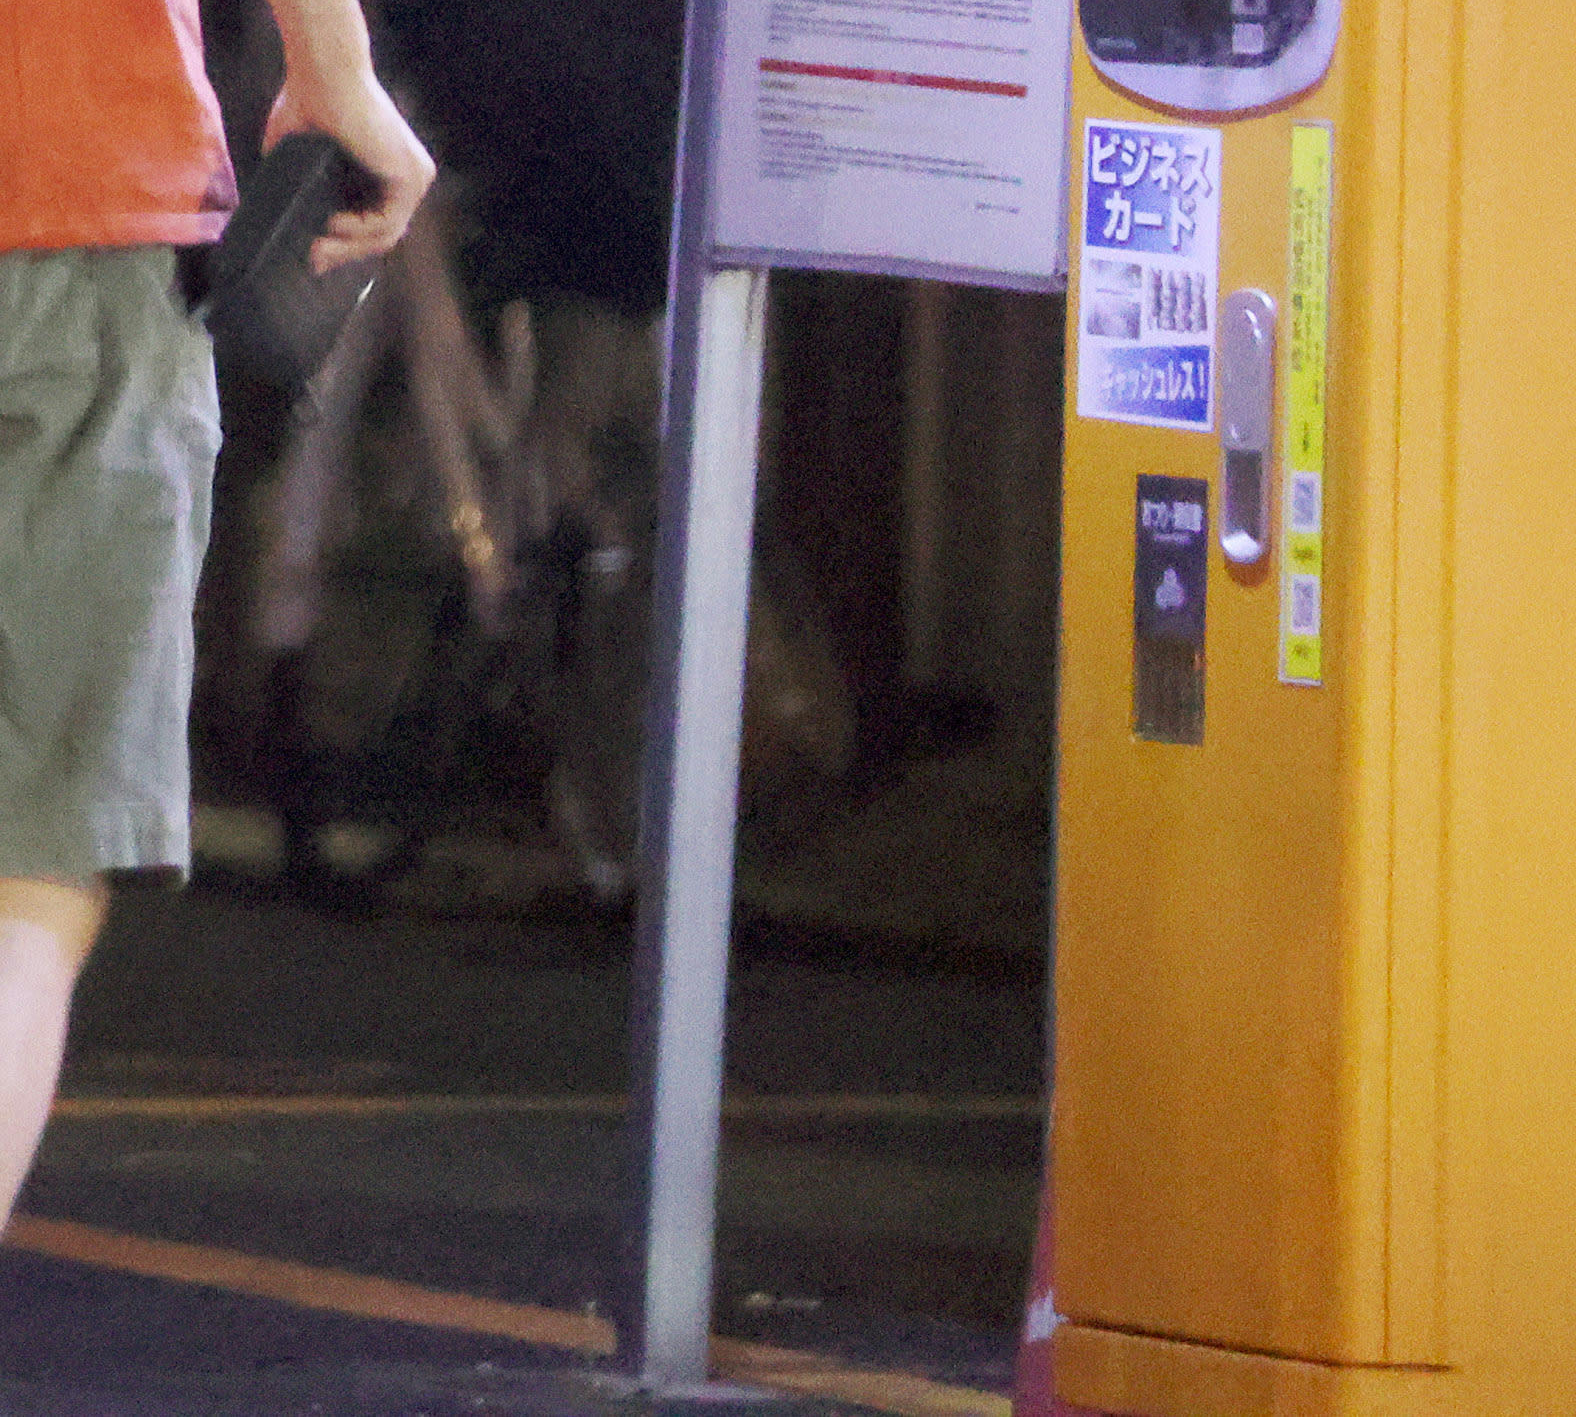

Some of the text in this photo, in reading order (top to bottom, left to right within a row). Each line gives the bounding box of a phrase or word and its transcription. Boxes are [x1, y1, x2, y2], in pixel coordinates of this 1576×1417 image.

[1091, 133, 1214, 199] ビジネス
[1102, 189, 1198, 252] カード
